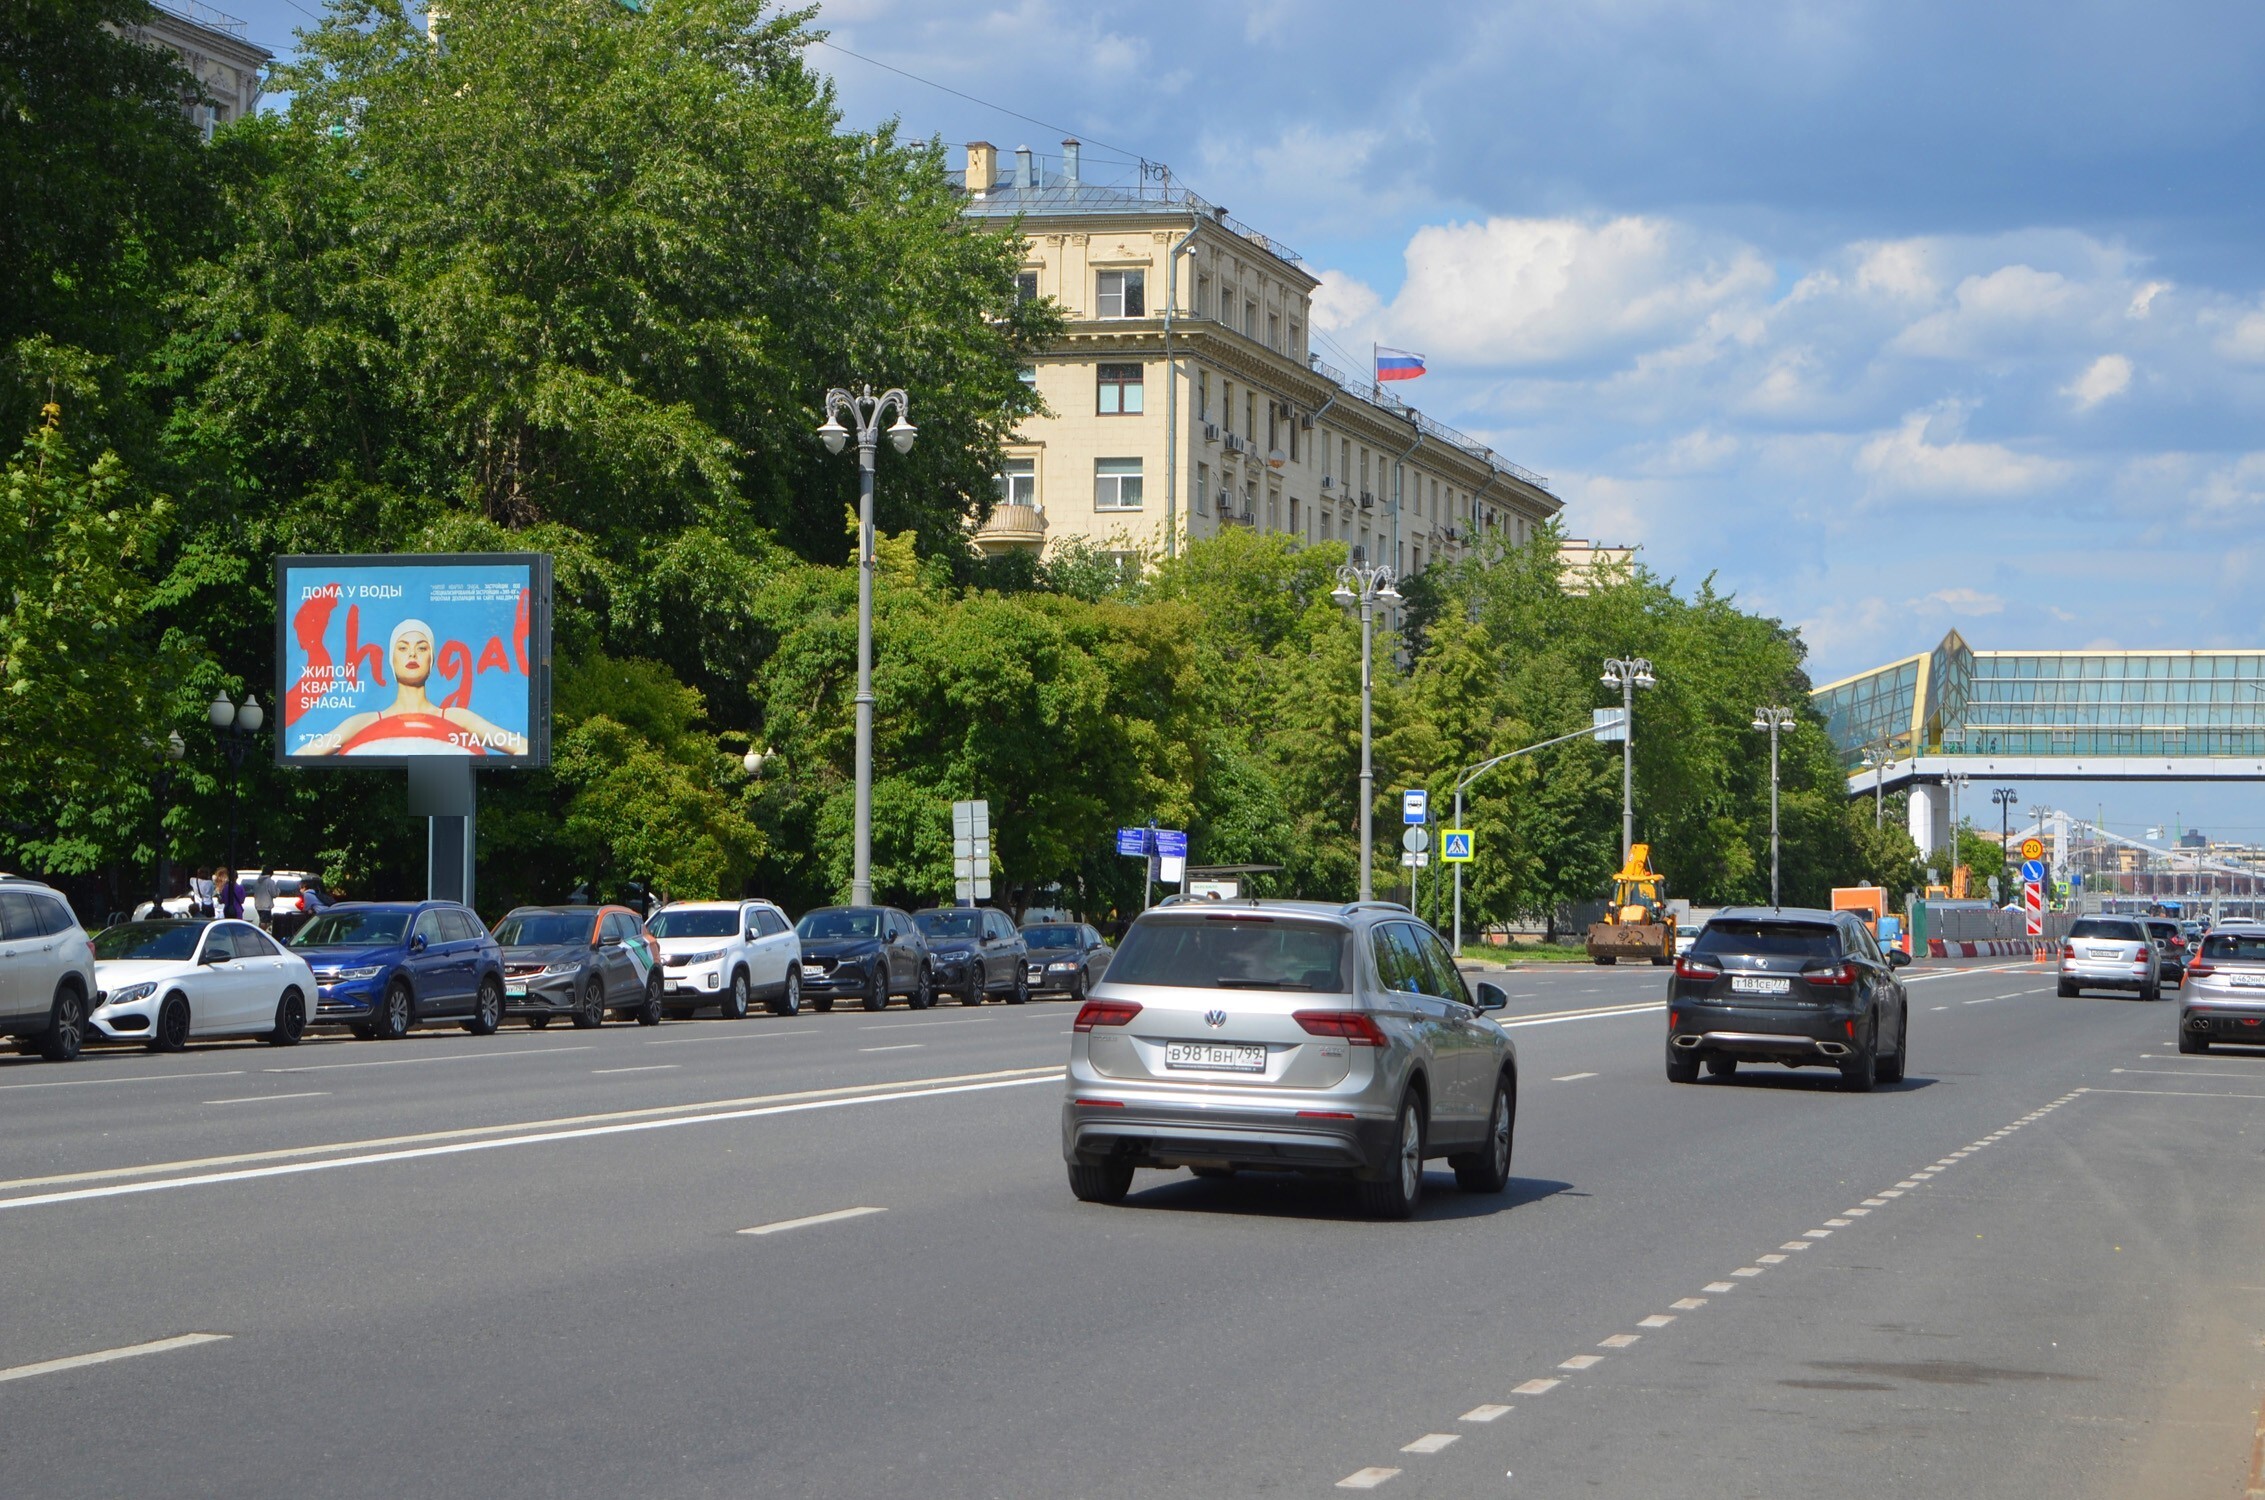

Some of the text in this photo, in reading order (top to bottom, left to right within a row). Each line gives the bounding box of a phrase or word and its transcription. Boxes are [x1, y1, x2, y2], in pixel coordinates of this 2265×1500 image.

[301, 585, 403, 601] ДОМА У ВОДЫ
[301, 662, 355, 678] ЖИЛОЙ
[301, 681, 365, 694] КВАРТАЛ
[300, 696, 356, 709] SHAGAL
[448, 732, 521, 748] ЭТАЛОН
[2026, 844, 2039, 854] 20
[1237, 1046, 1260, 1060] 799
